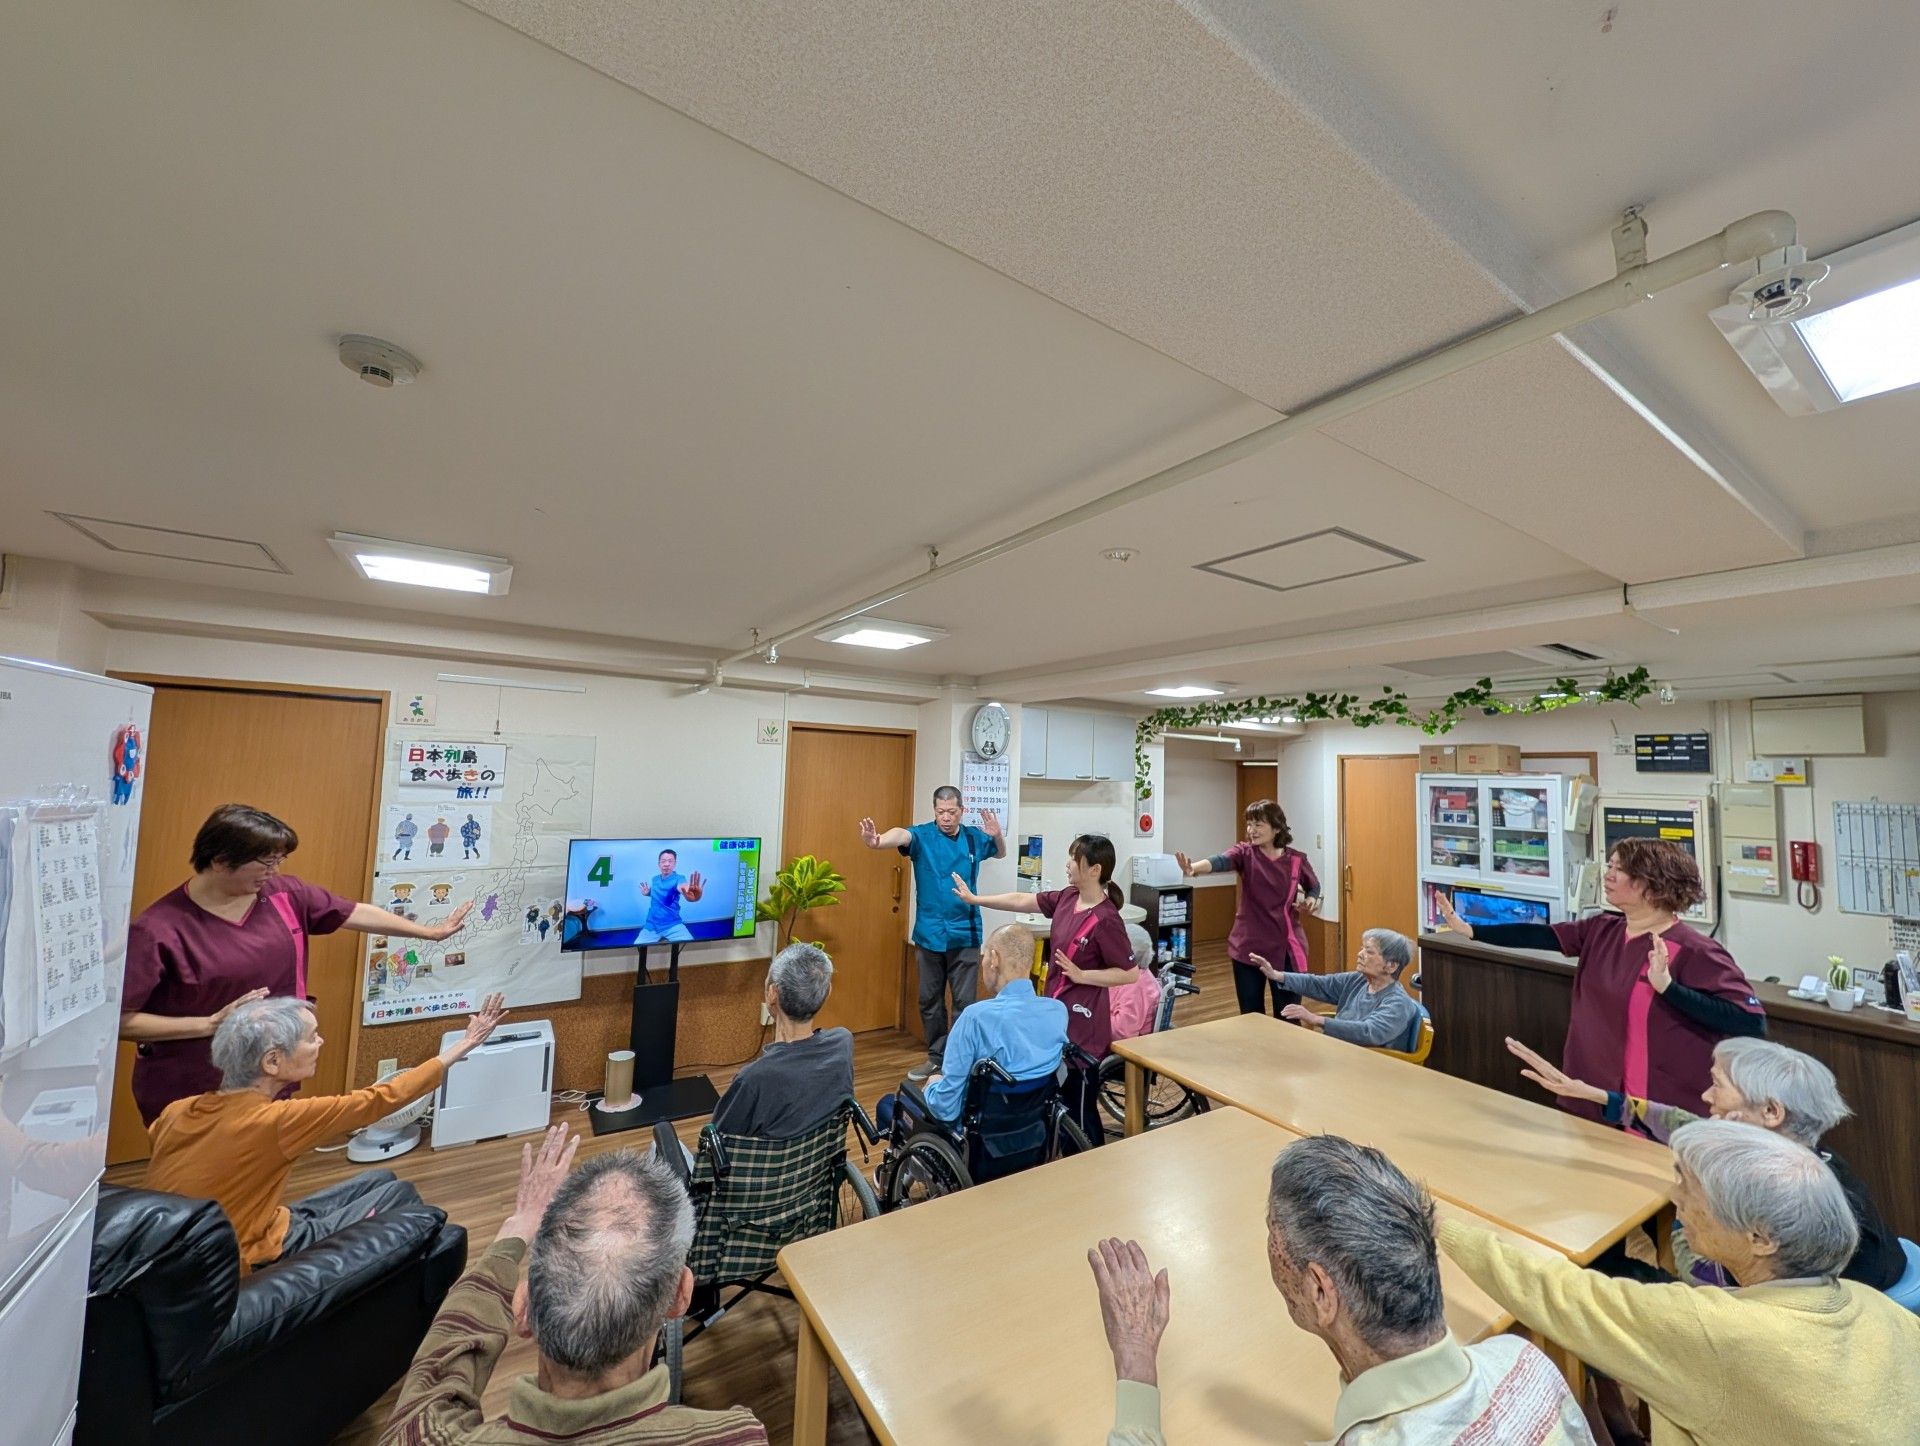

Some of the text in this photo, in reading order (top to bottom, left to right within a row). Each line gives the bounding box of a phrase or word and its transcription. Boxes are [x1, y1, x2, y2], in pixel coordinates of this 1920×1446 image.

[408, 748, 478, 764] 日本列島
[410, 767, 496, 782] 食べ歩きの
[456, 786, 490, 799] 旅!!
[719, 840, 755, 850] 健康体操
[587, 856, 614, 887] 4
